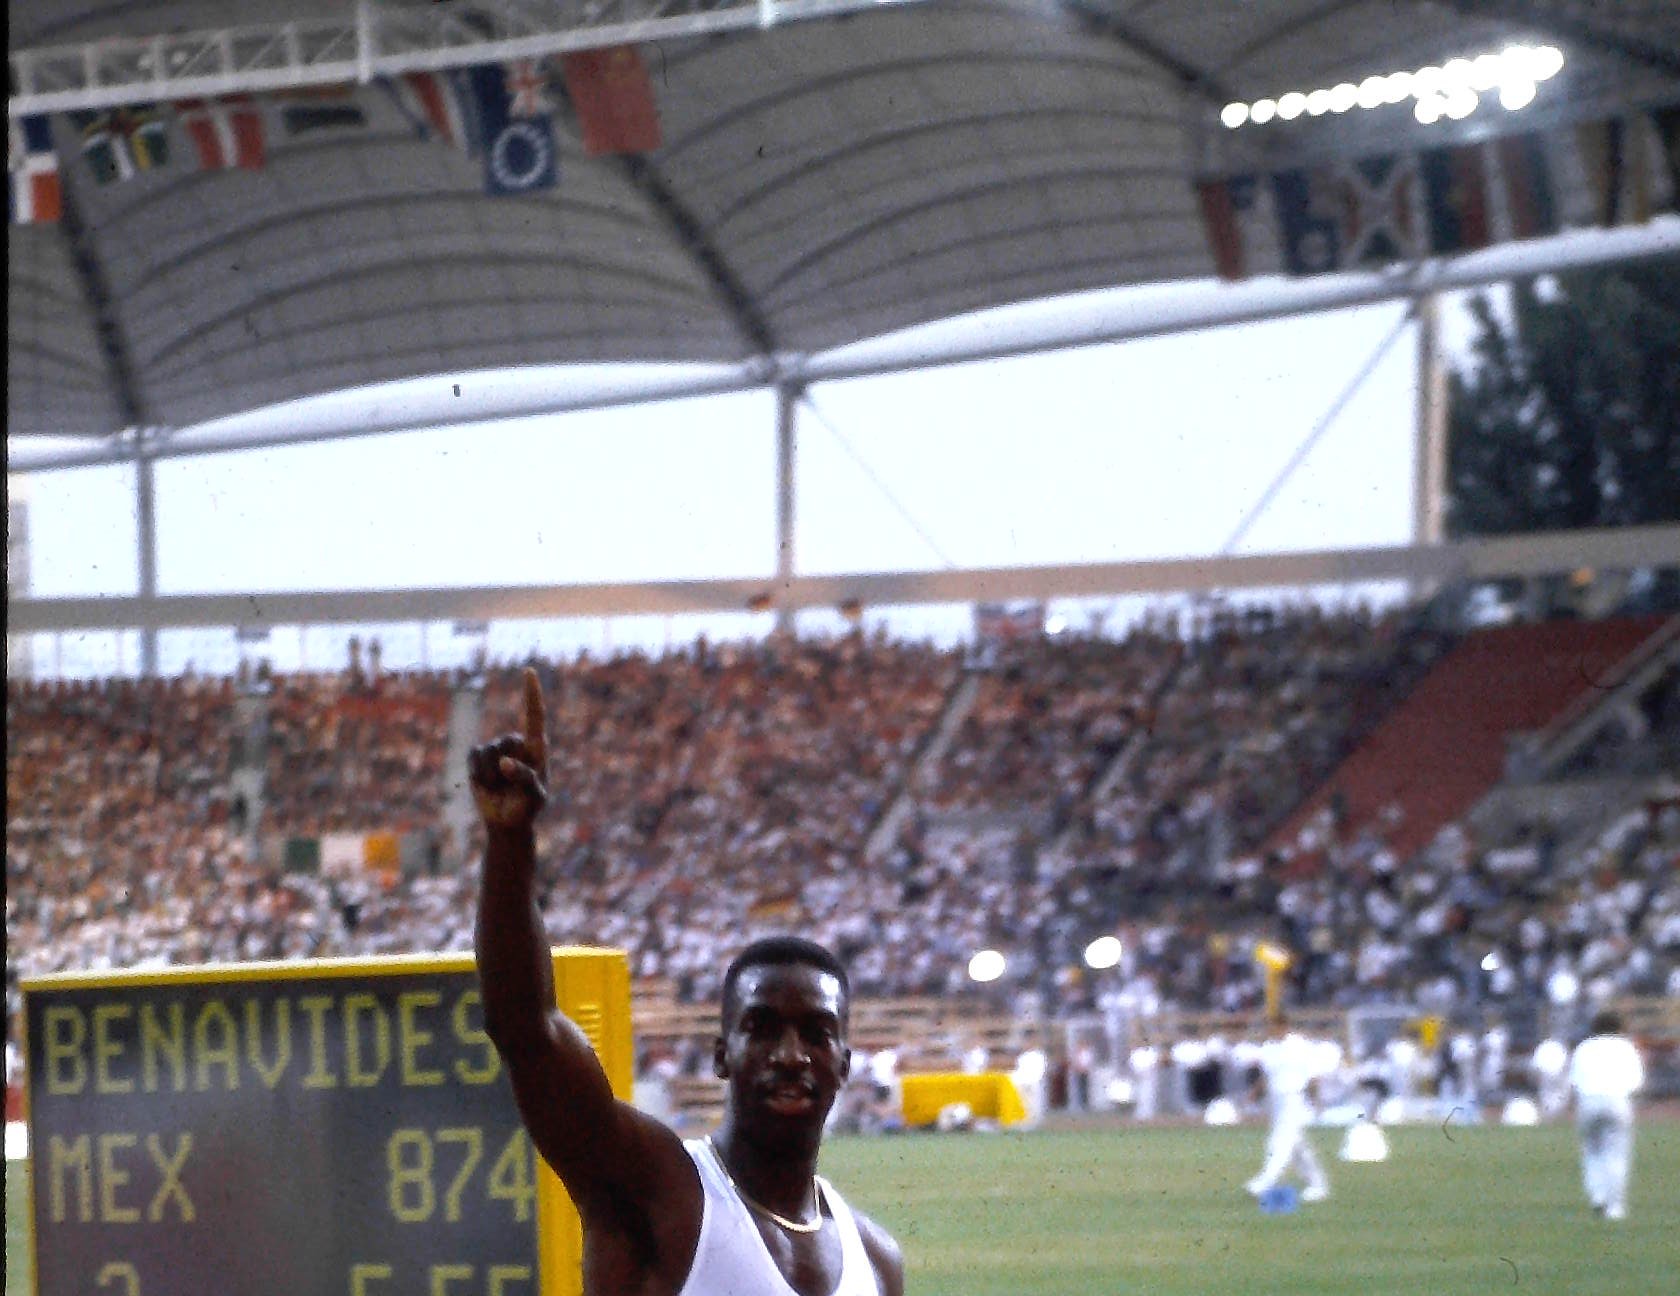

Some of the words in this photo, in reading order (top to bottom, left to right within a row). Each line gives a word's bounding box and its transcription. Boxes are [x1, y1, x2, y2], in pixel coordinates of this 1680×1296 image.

[43, 991, 501, 1095] BENAVIDES
[50, 1133, 195, 1223] MEX
[387, 1128, 536, 1223] 874
